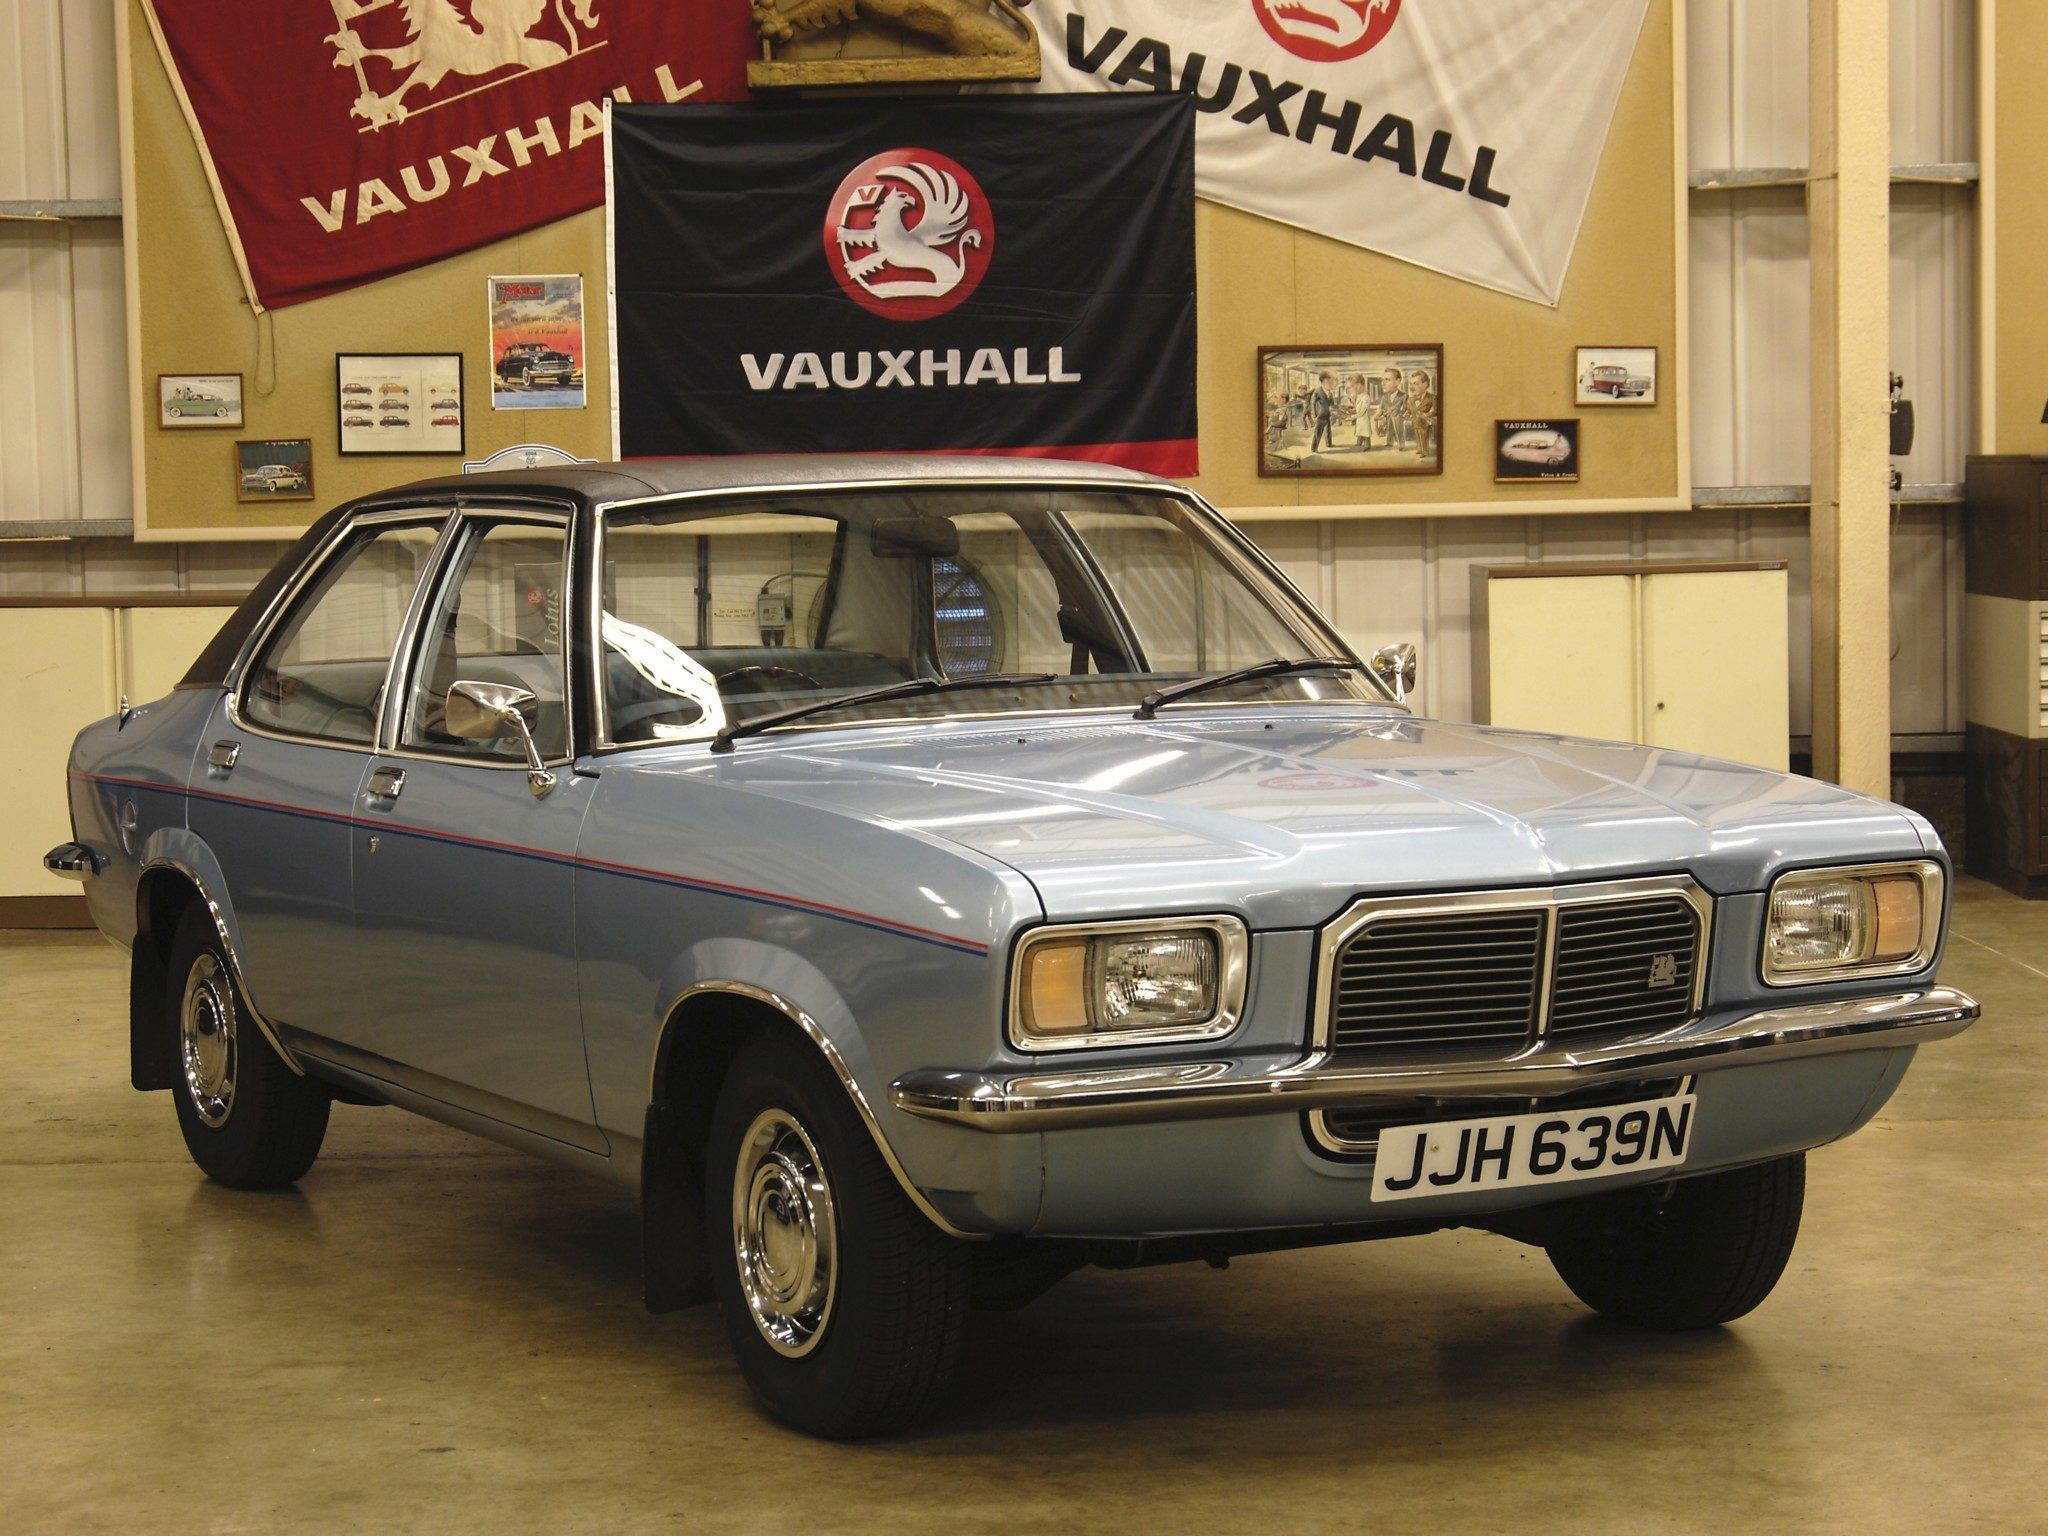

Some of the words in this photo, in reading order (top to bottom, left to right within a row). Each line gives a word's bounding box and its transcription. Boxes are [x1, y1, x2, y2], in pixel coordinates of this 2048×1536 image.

[299, 63, 704, 233] VAUXHAL
[1066, 12, 1511, 208] VAUXHALL
[739, 346, 1082, 391] VAUXHALL
[1384, 1125, 1516, 1192] JJH
[1528, 1102, 1692, 1177] 639N
